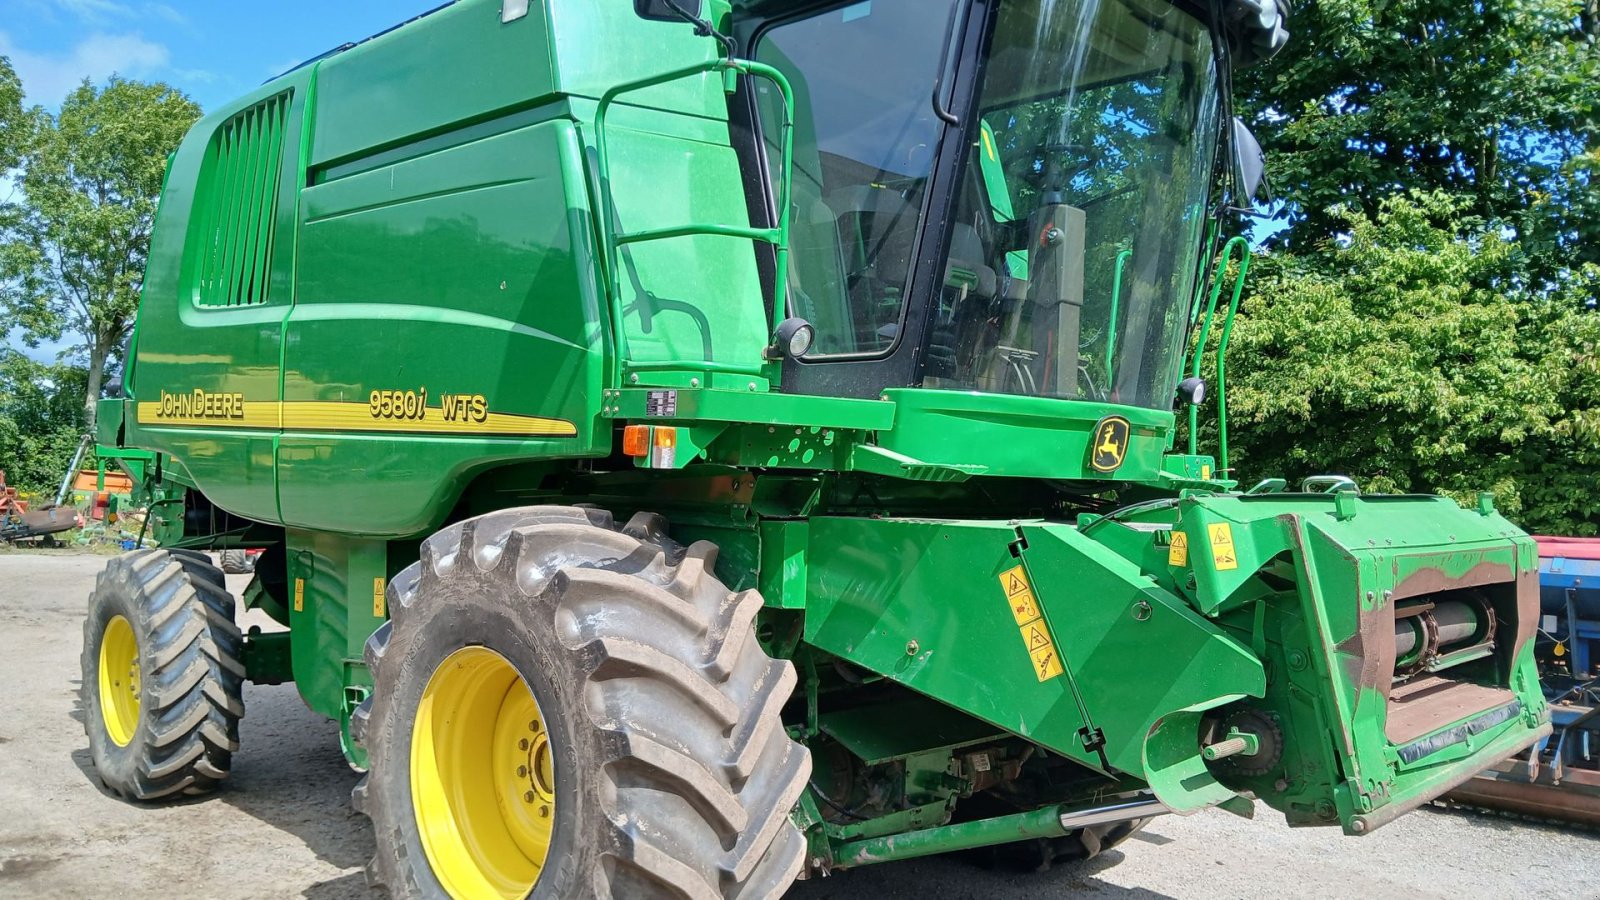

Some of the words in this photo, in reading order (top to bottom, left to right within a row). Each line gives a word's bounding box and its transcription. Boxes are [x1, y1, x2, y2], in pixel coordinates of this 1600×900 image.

[156, 389, 192, 417] JOHN
[193, 388, 244, 418] DEERE
[370, 387, 426, 420] 9580i
[441, 394, 487, 422] WTS
